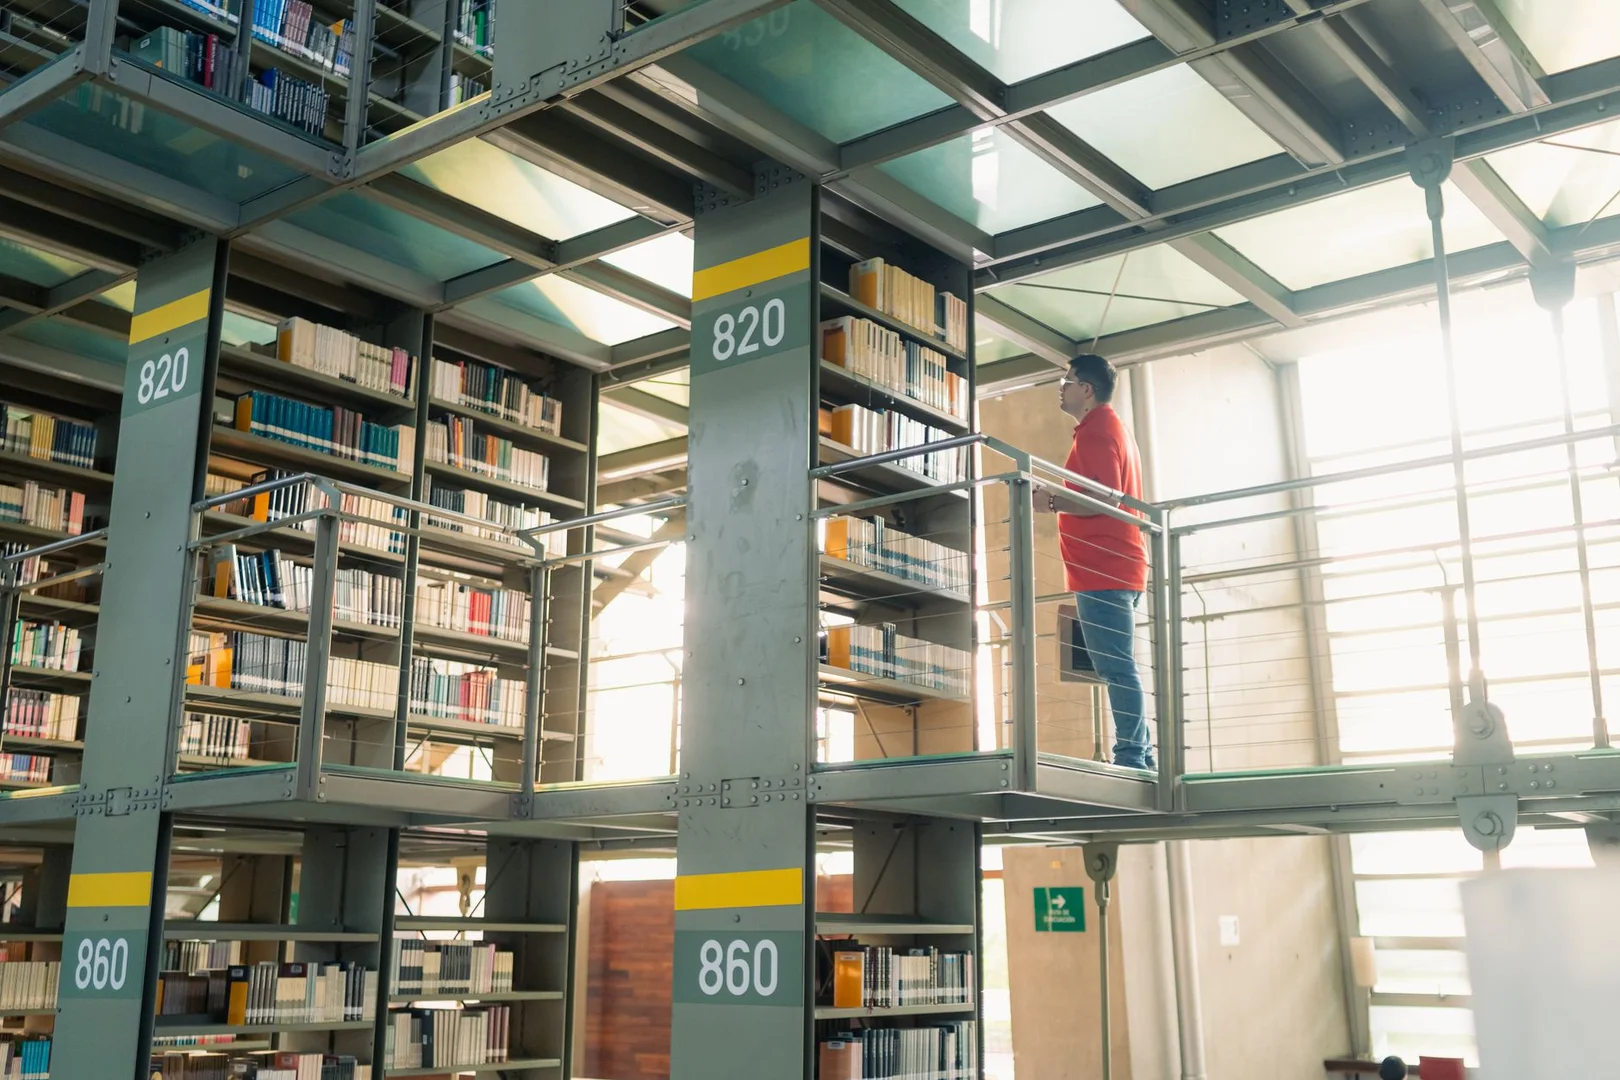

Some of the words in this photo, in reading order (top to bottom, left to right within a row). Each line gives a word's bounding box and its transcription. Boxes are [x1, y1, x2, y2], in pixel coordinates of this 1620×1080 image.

[713, 298, 785, 361] 820
[138, 347, 189, 404] 820
[75, 938, 129, 991] 860
[699, 939, 778, 996] 860
